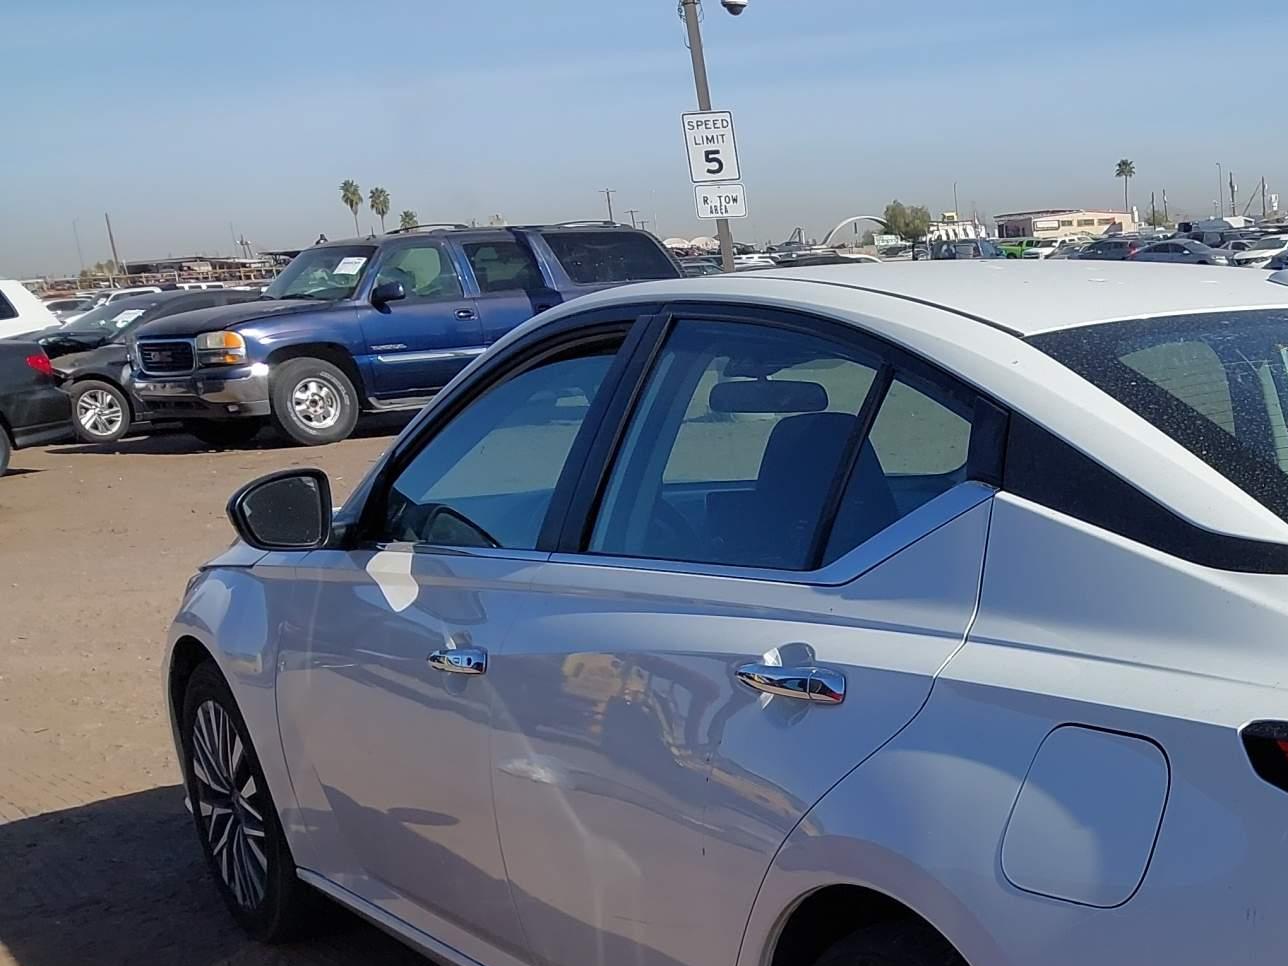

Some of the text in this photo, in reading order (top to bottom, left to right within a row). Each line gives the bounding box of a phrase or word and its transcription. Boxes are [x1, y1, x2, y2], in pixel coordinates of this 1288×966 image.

[687, 119, 729, 131] SPEED
[693, 134, 726, 146] LIMIT
[704, 149, 724, 175] 5
[717, 194, 738, 206] TOW
